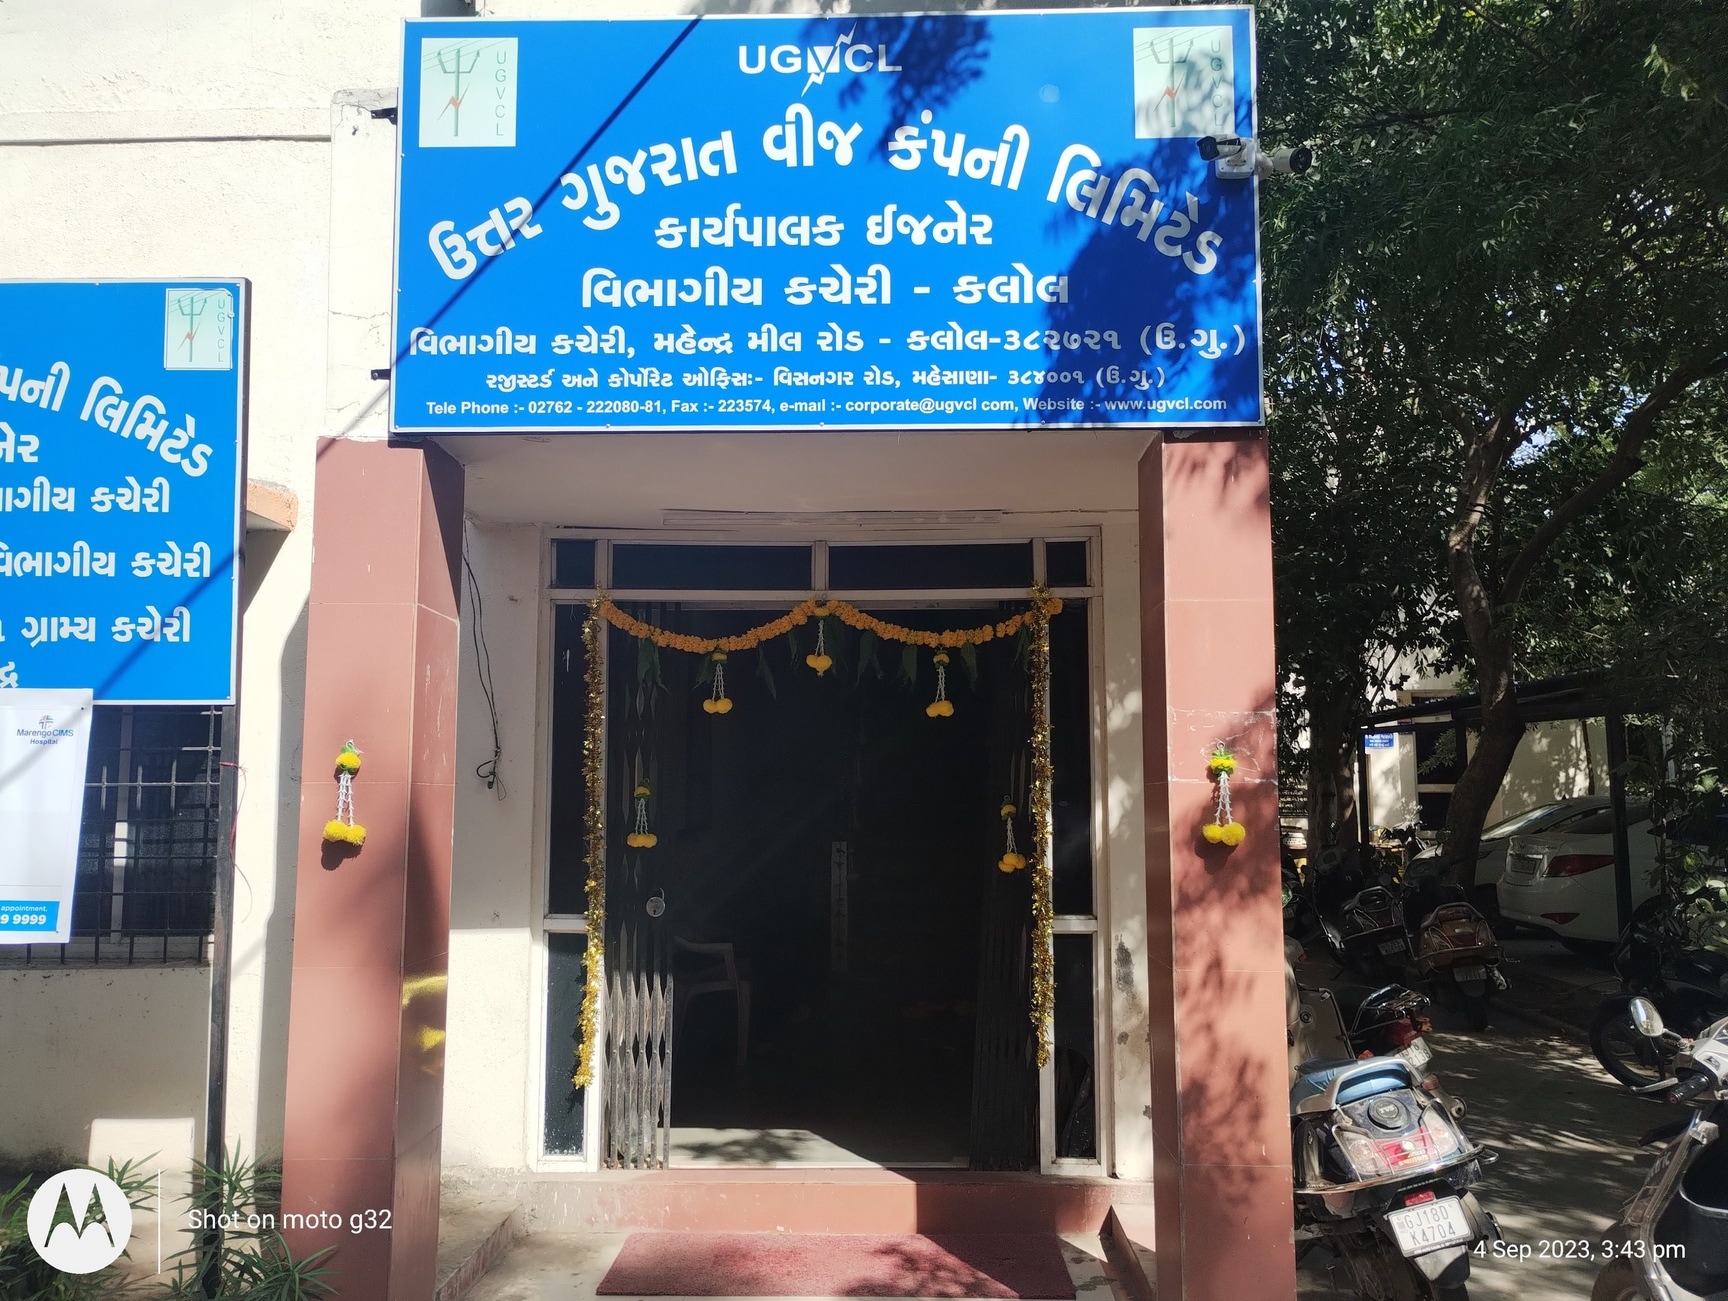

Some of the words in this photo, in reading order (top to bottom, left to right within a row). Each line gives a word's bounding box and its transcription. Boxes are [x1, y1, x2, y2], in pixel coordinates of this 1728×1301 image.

[738, 44, 902, 74] UGVCL
[495, 50, 507, 136] UGVCL
[1210, 40, 1223, 126] UGVCL
[428, 197, 543, 280] ઉત્તર
[560, 130, 737, 230] ગુજરાત
[763, 103, 863, 167] વીજ
[888, 109, 1030, 190] કંપની
[1046, 143, 1223, 275] લિમિટેડ
[655, 203, 844, 248] કાર્યપાલક
[866, 200, 992, 245] ઈજનેર
[582, 266, 762, 307] વિભાગીય
[784, 264, 891, 305] કચેરી
[913, 286, 931, 295] -
[953, 263, 1068, 304] કલોલ
[217, 298, 226, 362] UGVCL
[410, 326, 536, 355] વિભાગીય
[551, 325, 635, 358] કચેરી,
[654, 324, 733, 354] મહેન્દ્ર
[748, 323, 801, 352] મીલ
[817, 322, 864, 351] રોડ
[907, 321, 1121, 351] કલોલ-૩૮૨૭૨૧
[562, 368, 598, 387] અને
[608, 367, 673, 387] કોર્પોરેટ
[774, 366, 853, 386] વિસનગર
[863, 365, 900, 388] રોડ,
[912, 365, 997, 386] મહેસાણા-
[1008, 370, 1084, 384] ૩૮૪૦૦૧
[426, 402, 456, 414] Tele
[461, 401, 509, 414] Phone
[528, 401, 572, 413] 02762
[587, 400, 666, 414] 222080-81,
[672, 400, 698, 412] Fax
[718, 399, 775, 414] 223574,
[780, 399, 825, 412] e-mail
[1023, 398, 1084, 410] Website
[1105, 397, 1226, 413] www.ugvcl.com
[80, 376, 213, 477] લિમિટેડ
[91, 476, 169, 512] કચેરી
[131, 541, 210, 577] કચેરી
[21, 617, 95, 647] ગ્રામ્ય
[111, 606, 190, 642] કચેરી
[17, 729, 51, 738] Marengo
[53, 729, 74, 737] CIMS
[13, 914, 47, 925] 9999
[1410, 1221, 1456, 1246] K4704
